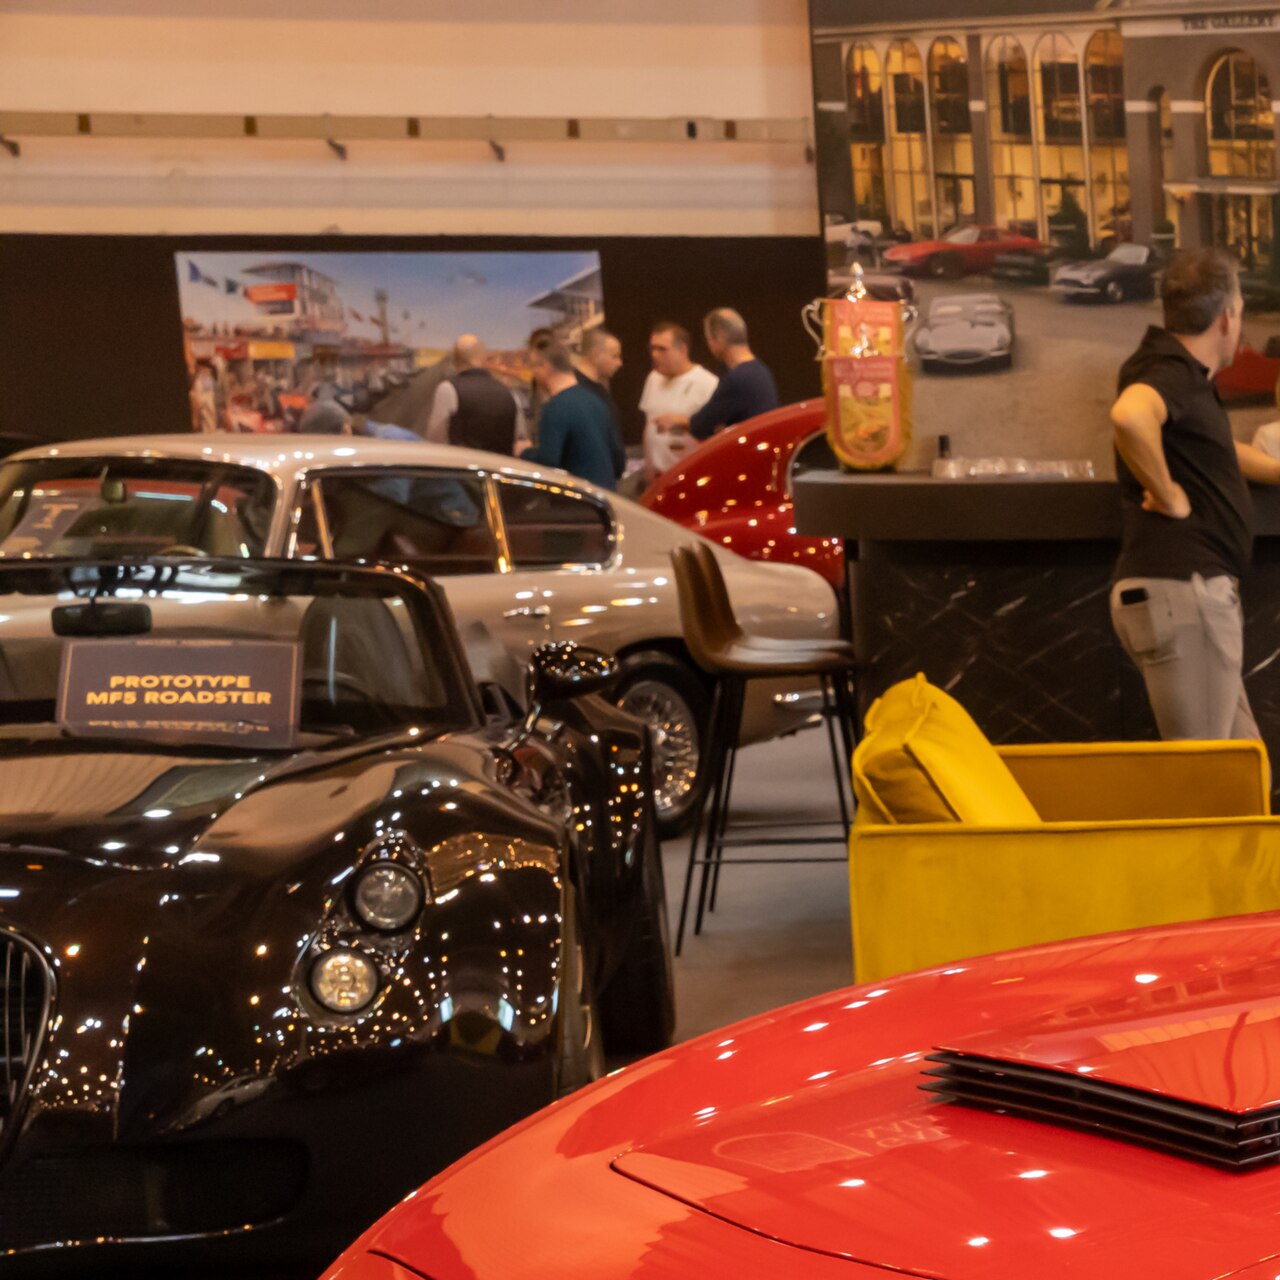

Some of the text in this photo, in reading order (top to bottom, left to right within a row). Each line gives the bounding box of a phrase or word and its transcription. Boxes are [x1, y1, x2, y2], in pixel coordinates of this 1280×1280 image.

[109, 675, 251, 689] PROTOTYPE
[86, 690, 272, 705] MF5 ROADSTER
